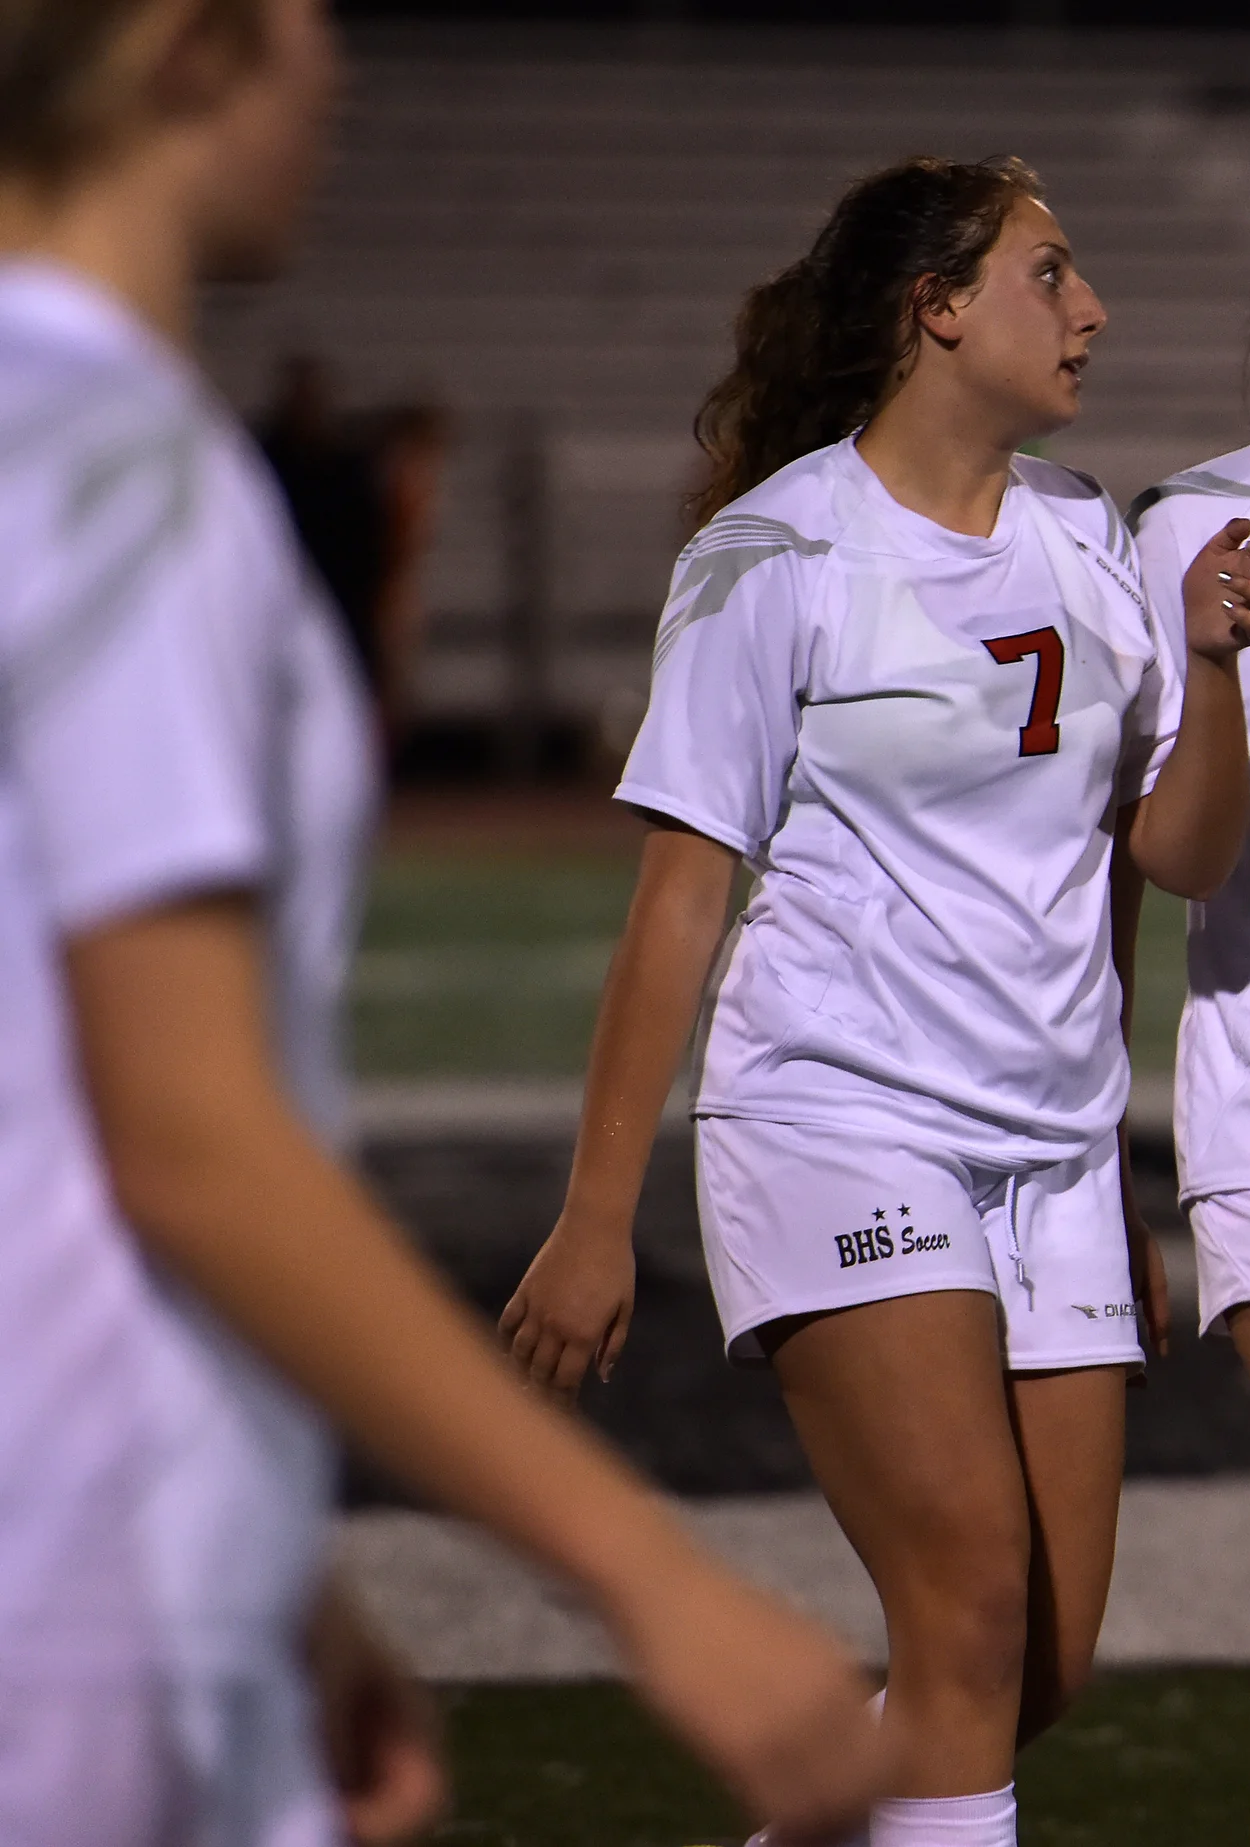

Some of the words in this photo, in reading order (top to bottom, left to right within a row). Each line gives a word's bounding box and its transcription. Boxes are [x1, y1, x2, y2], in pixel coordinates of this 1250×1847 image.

[981, 626, 1064, 757] 7
[834, 1225, 895, 1268] BHS
[901, 1226, 950, 1255] Soccer
